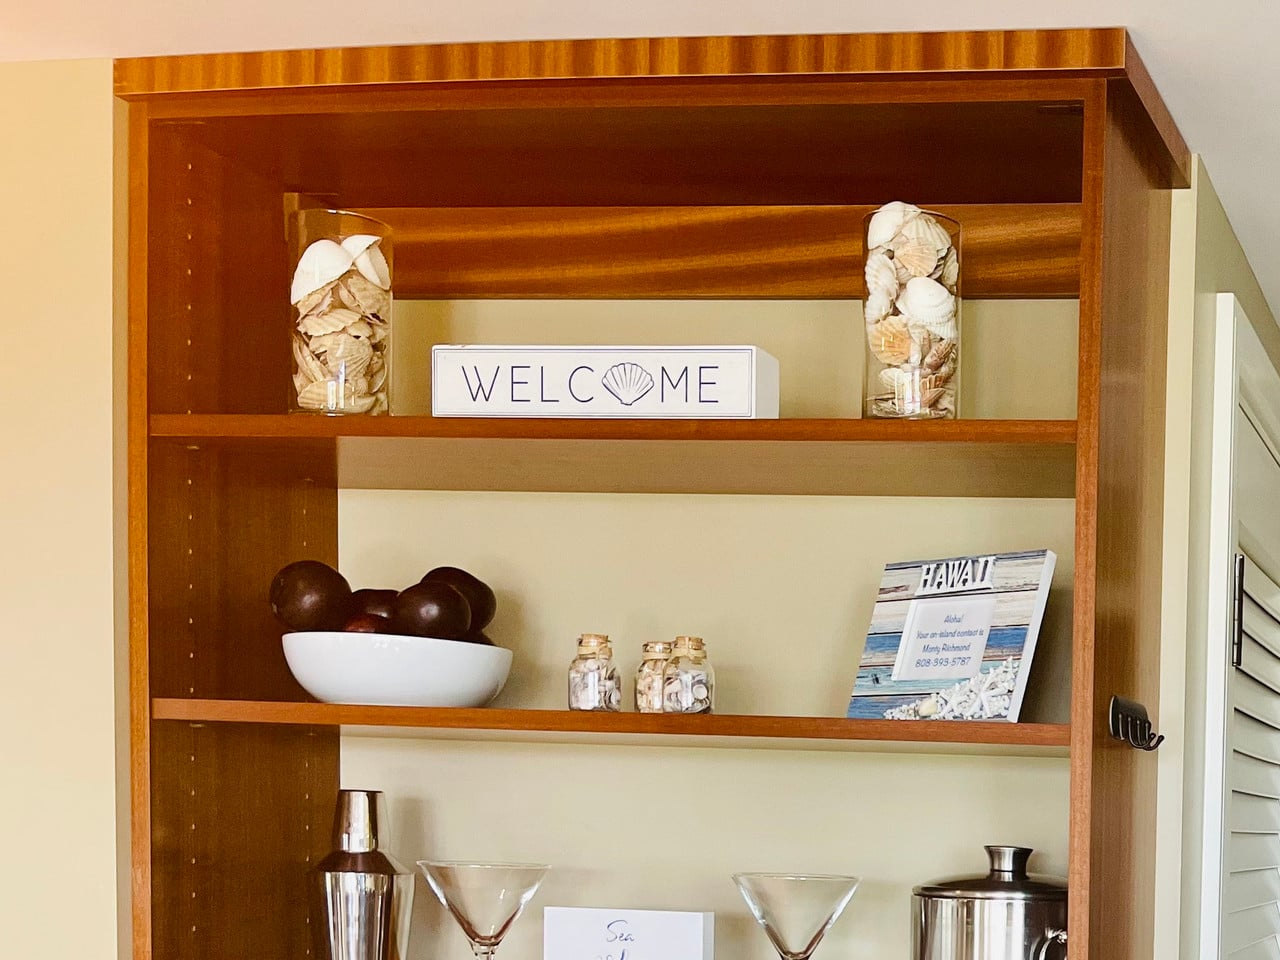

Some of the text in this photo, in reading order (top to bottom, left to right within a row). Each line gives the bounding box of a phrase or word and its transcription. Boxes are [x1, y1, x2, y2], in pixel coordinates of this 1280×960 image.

[957, 628, 978, 637] contact
[942, 643, 971, 652] Richmond
[606, 919, 635, 943] Sea
